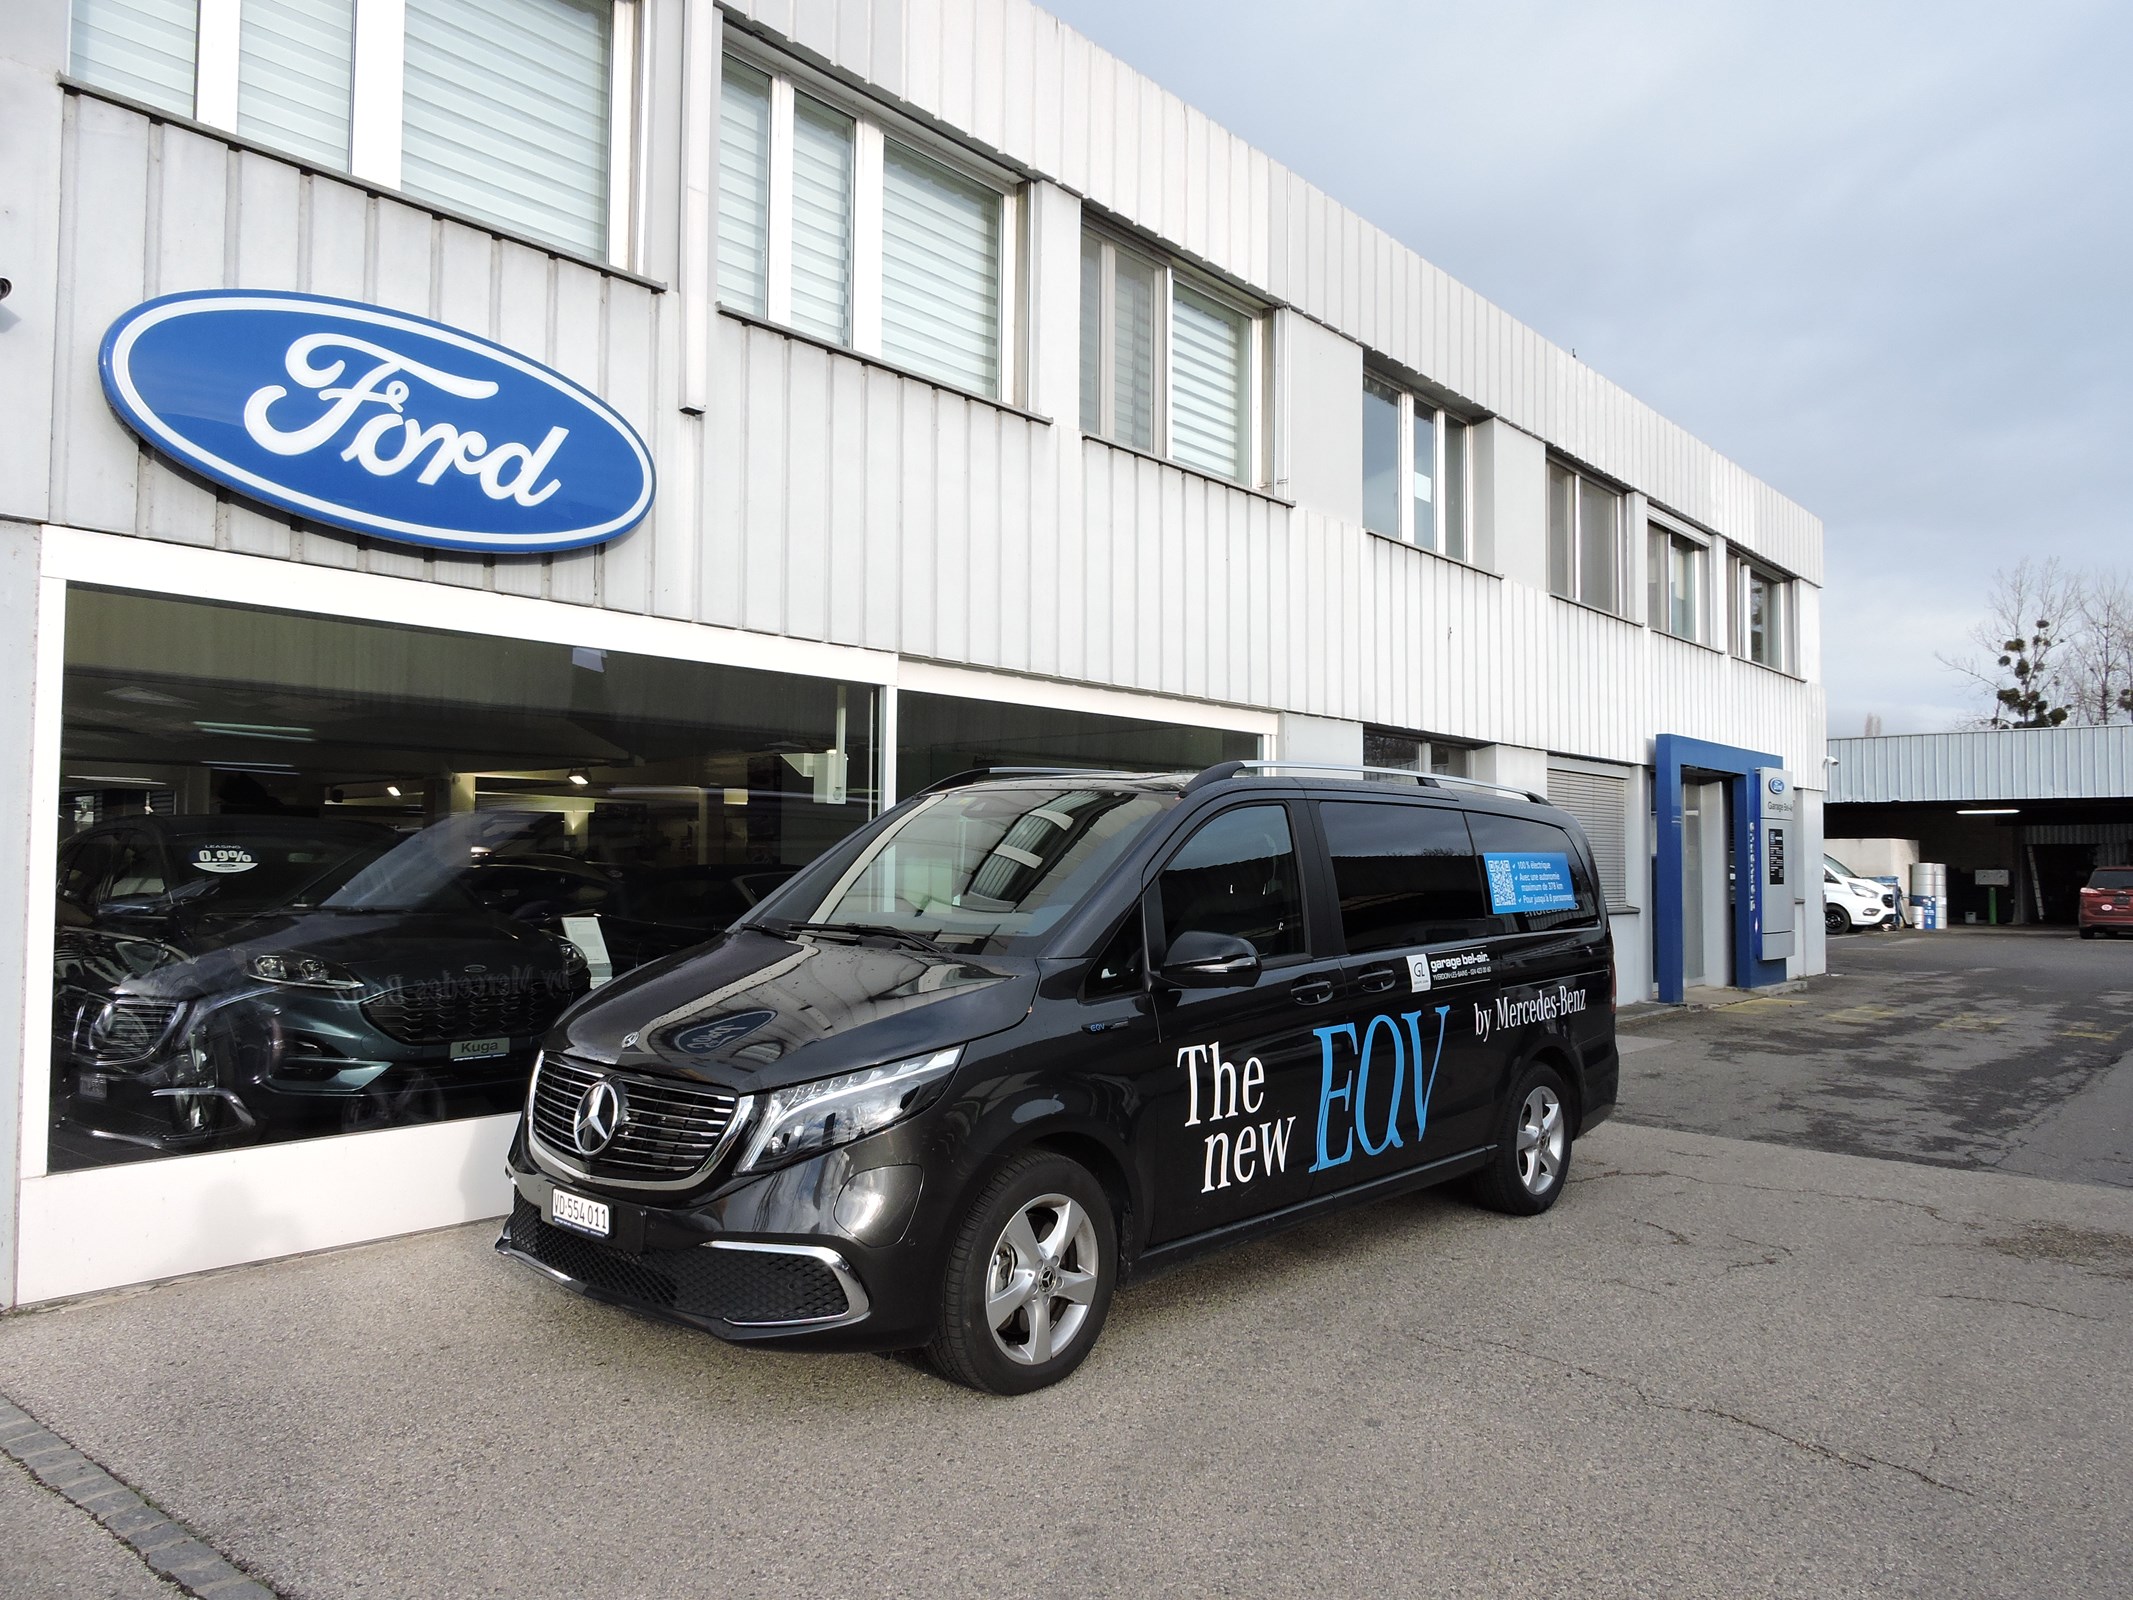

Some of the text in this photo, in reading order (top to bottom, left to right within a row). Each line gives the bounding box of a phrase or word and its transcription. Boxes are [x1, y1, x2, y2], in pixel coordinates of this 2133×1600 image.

[244, 333, 569, 507] Ford
[1768, 801, 1783, 812] Garage
[198, 850, 252, 862] 0.9%
[1519, 872, 1530, 881] Avec
[1522, 894, 1533, 903] Pour
[1430, 958, 1461, 972] garage
[1473, 985, 1587, 1042] by Mercedes-Benz
[1090, 1023, 1105, 1032] EQV
[461, 1042, 498, 1054] Kuga
[1176, 1041, 1265, 1128] The
[1308, 1005, 1450, 1174] EQV
[1200, 1116, 1297, 1194] new
